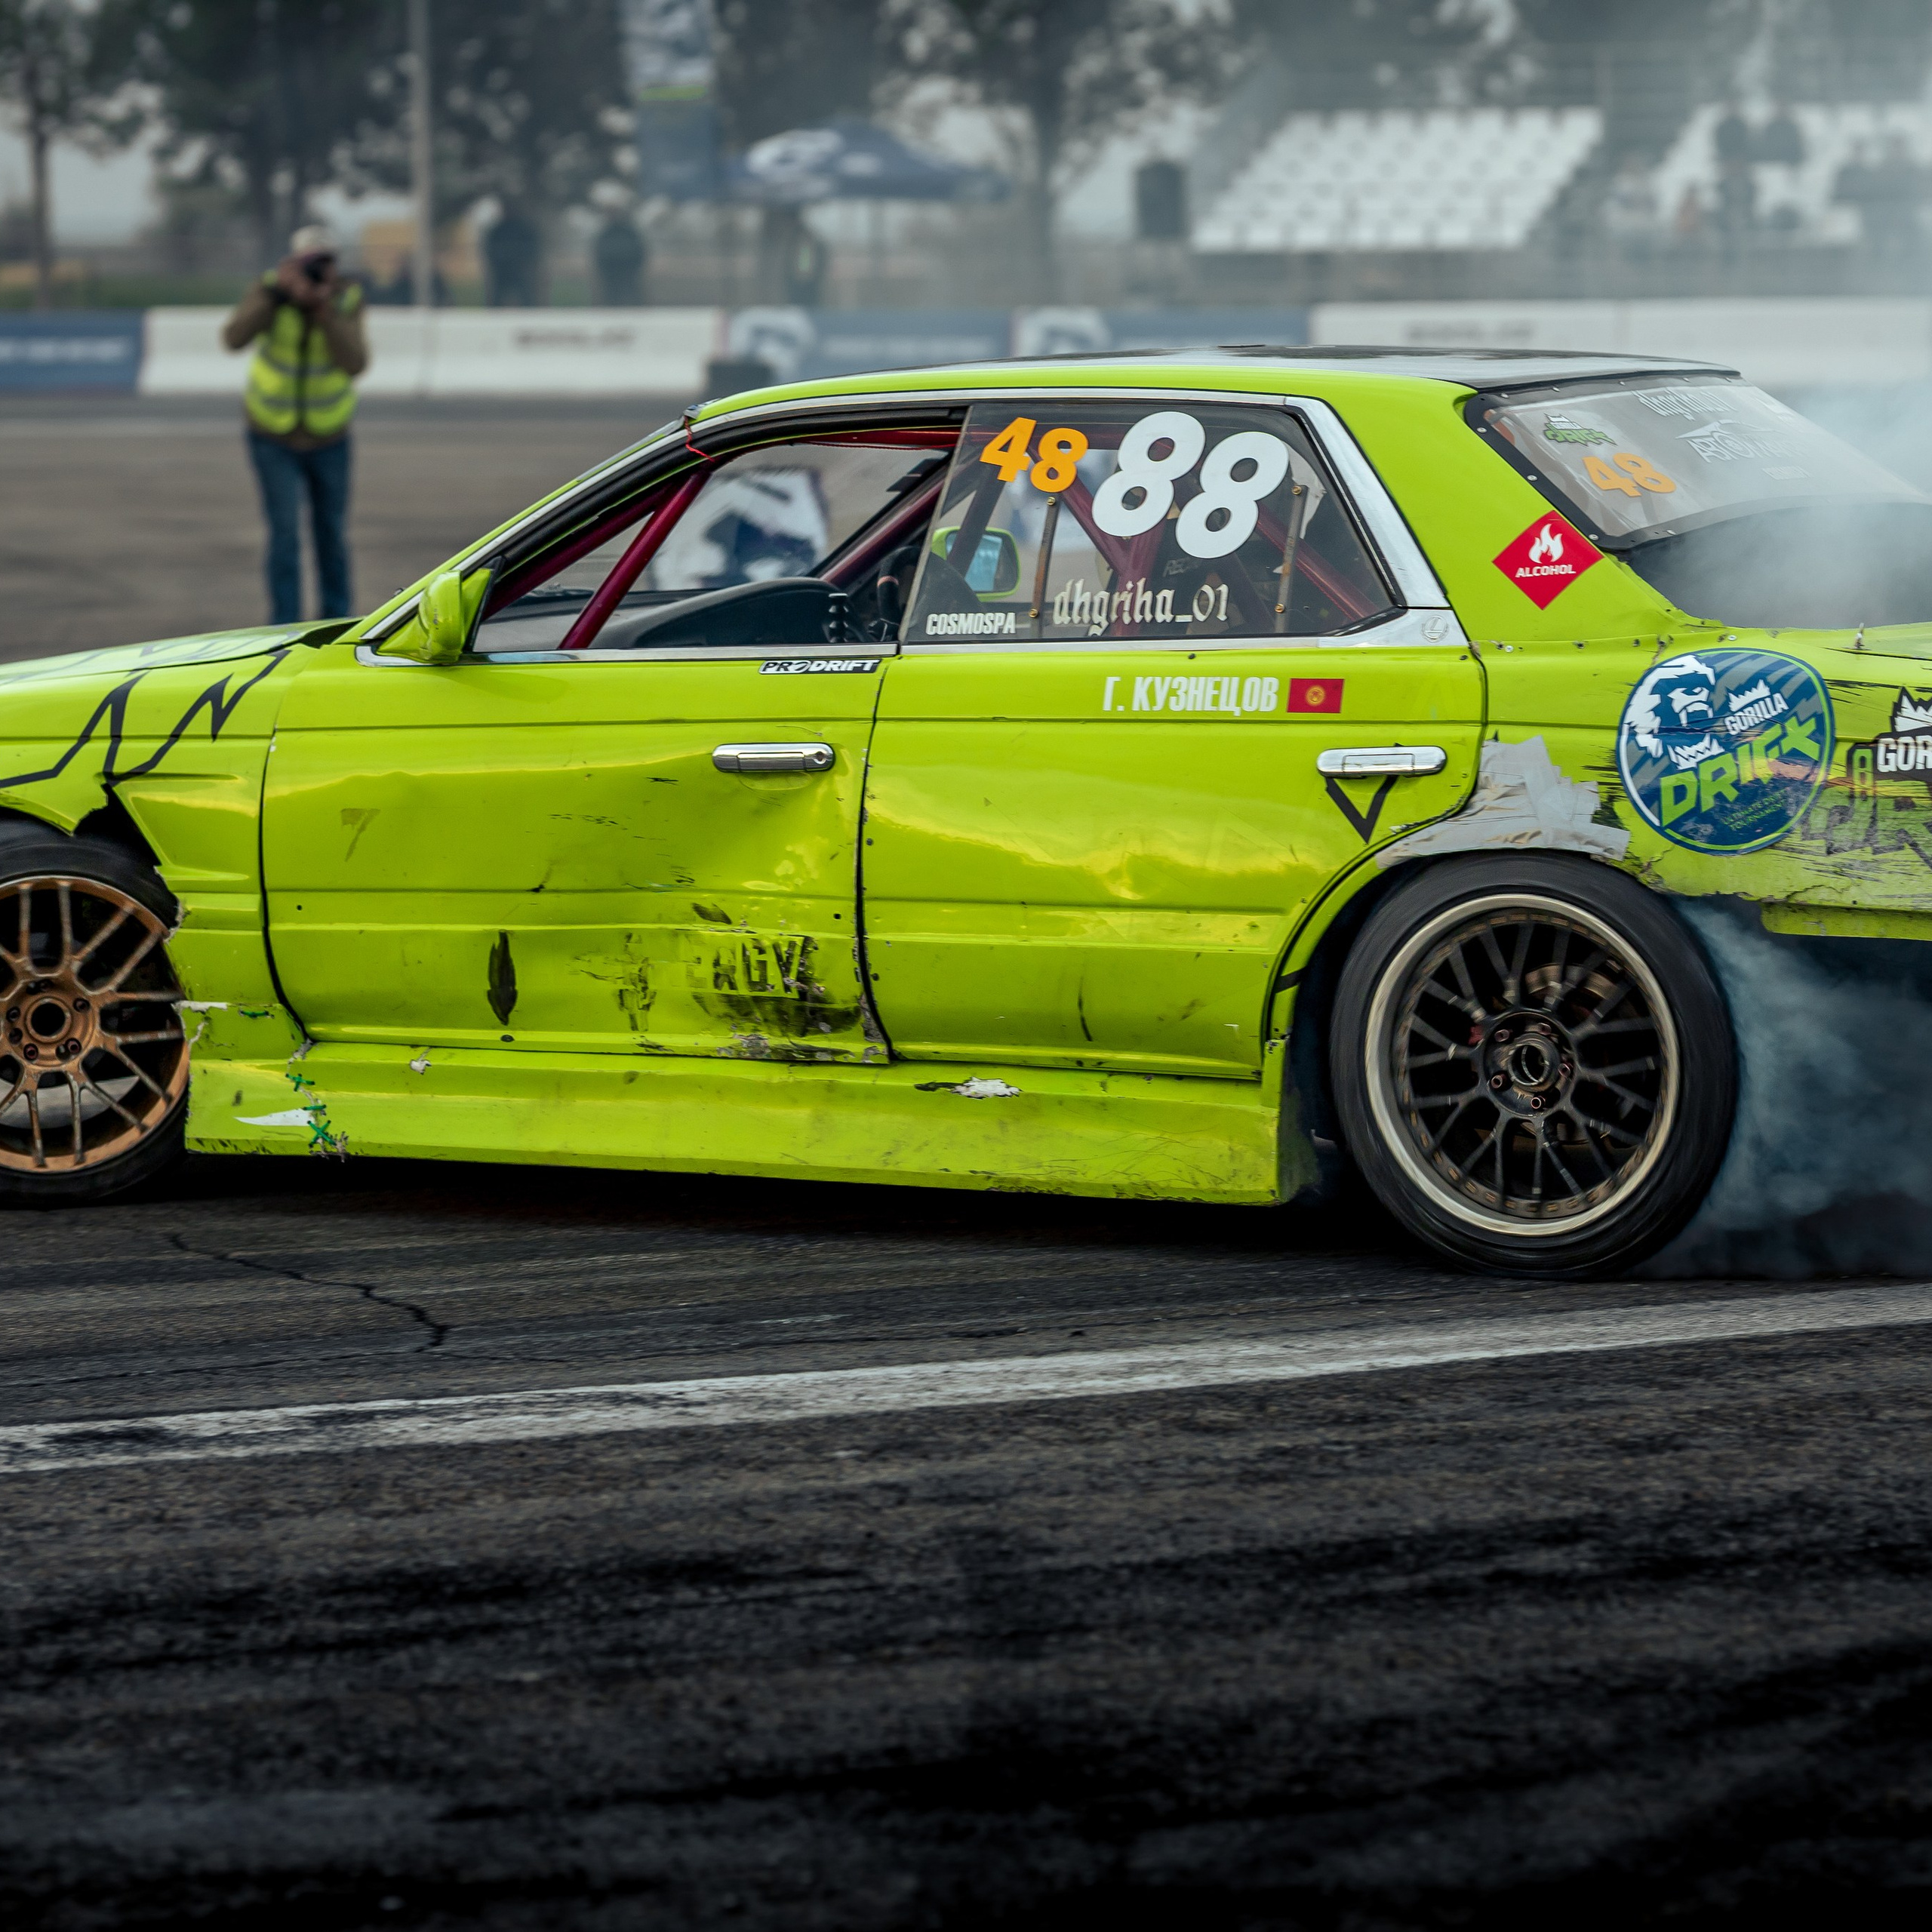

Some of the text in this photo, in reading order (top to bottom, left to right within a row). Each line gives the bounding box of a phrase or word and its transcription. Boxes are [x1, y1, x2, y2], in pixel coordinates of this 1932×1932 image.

[980, 417, 1088, 492] 48
[1583, 452, 1677, 497] 48
[1092, 411, 1288, 558] 88
[1515, 564, 1577, 578] ALCOHOL
[925, 612, 1017, 635] COSMOSPA
[1103, 676, 1279, 716] Г. КУЗНЕЦОВ
[1724, 692, 1789, 735] GORILLA
